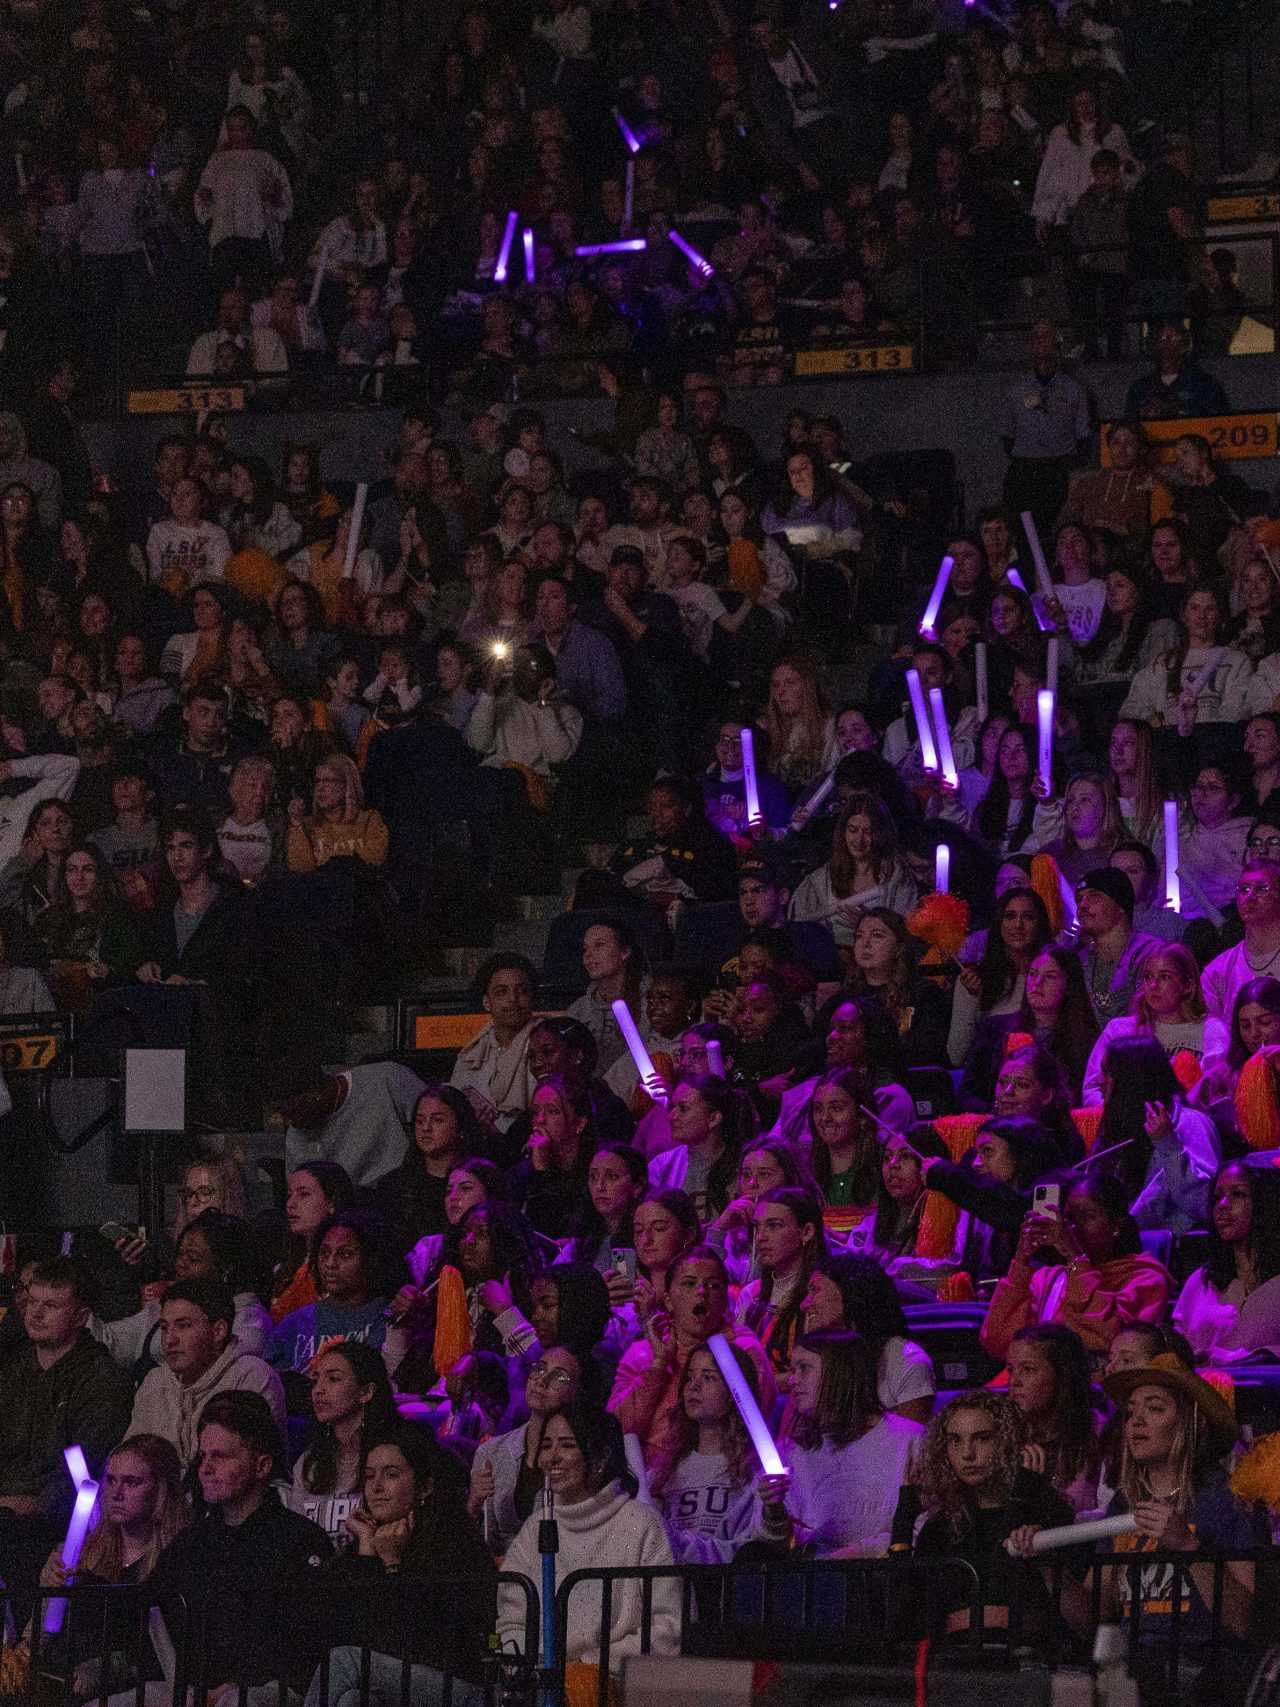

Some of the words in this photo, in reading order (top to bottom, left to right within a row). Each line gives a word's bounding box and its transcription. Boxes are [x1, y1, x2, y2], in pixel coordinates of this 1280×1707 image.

[846, 347, 901, 370] 313
[178, 388, 233, 412] 313
[1211, 425, 1268, 449] 209
[431, 1023, 476, 1038] SECTION
